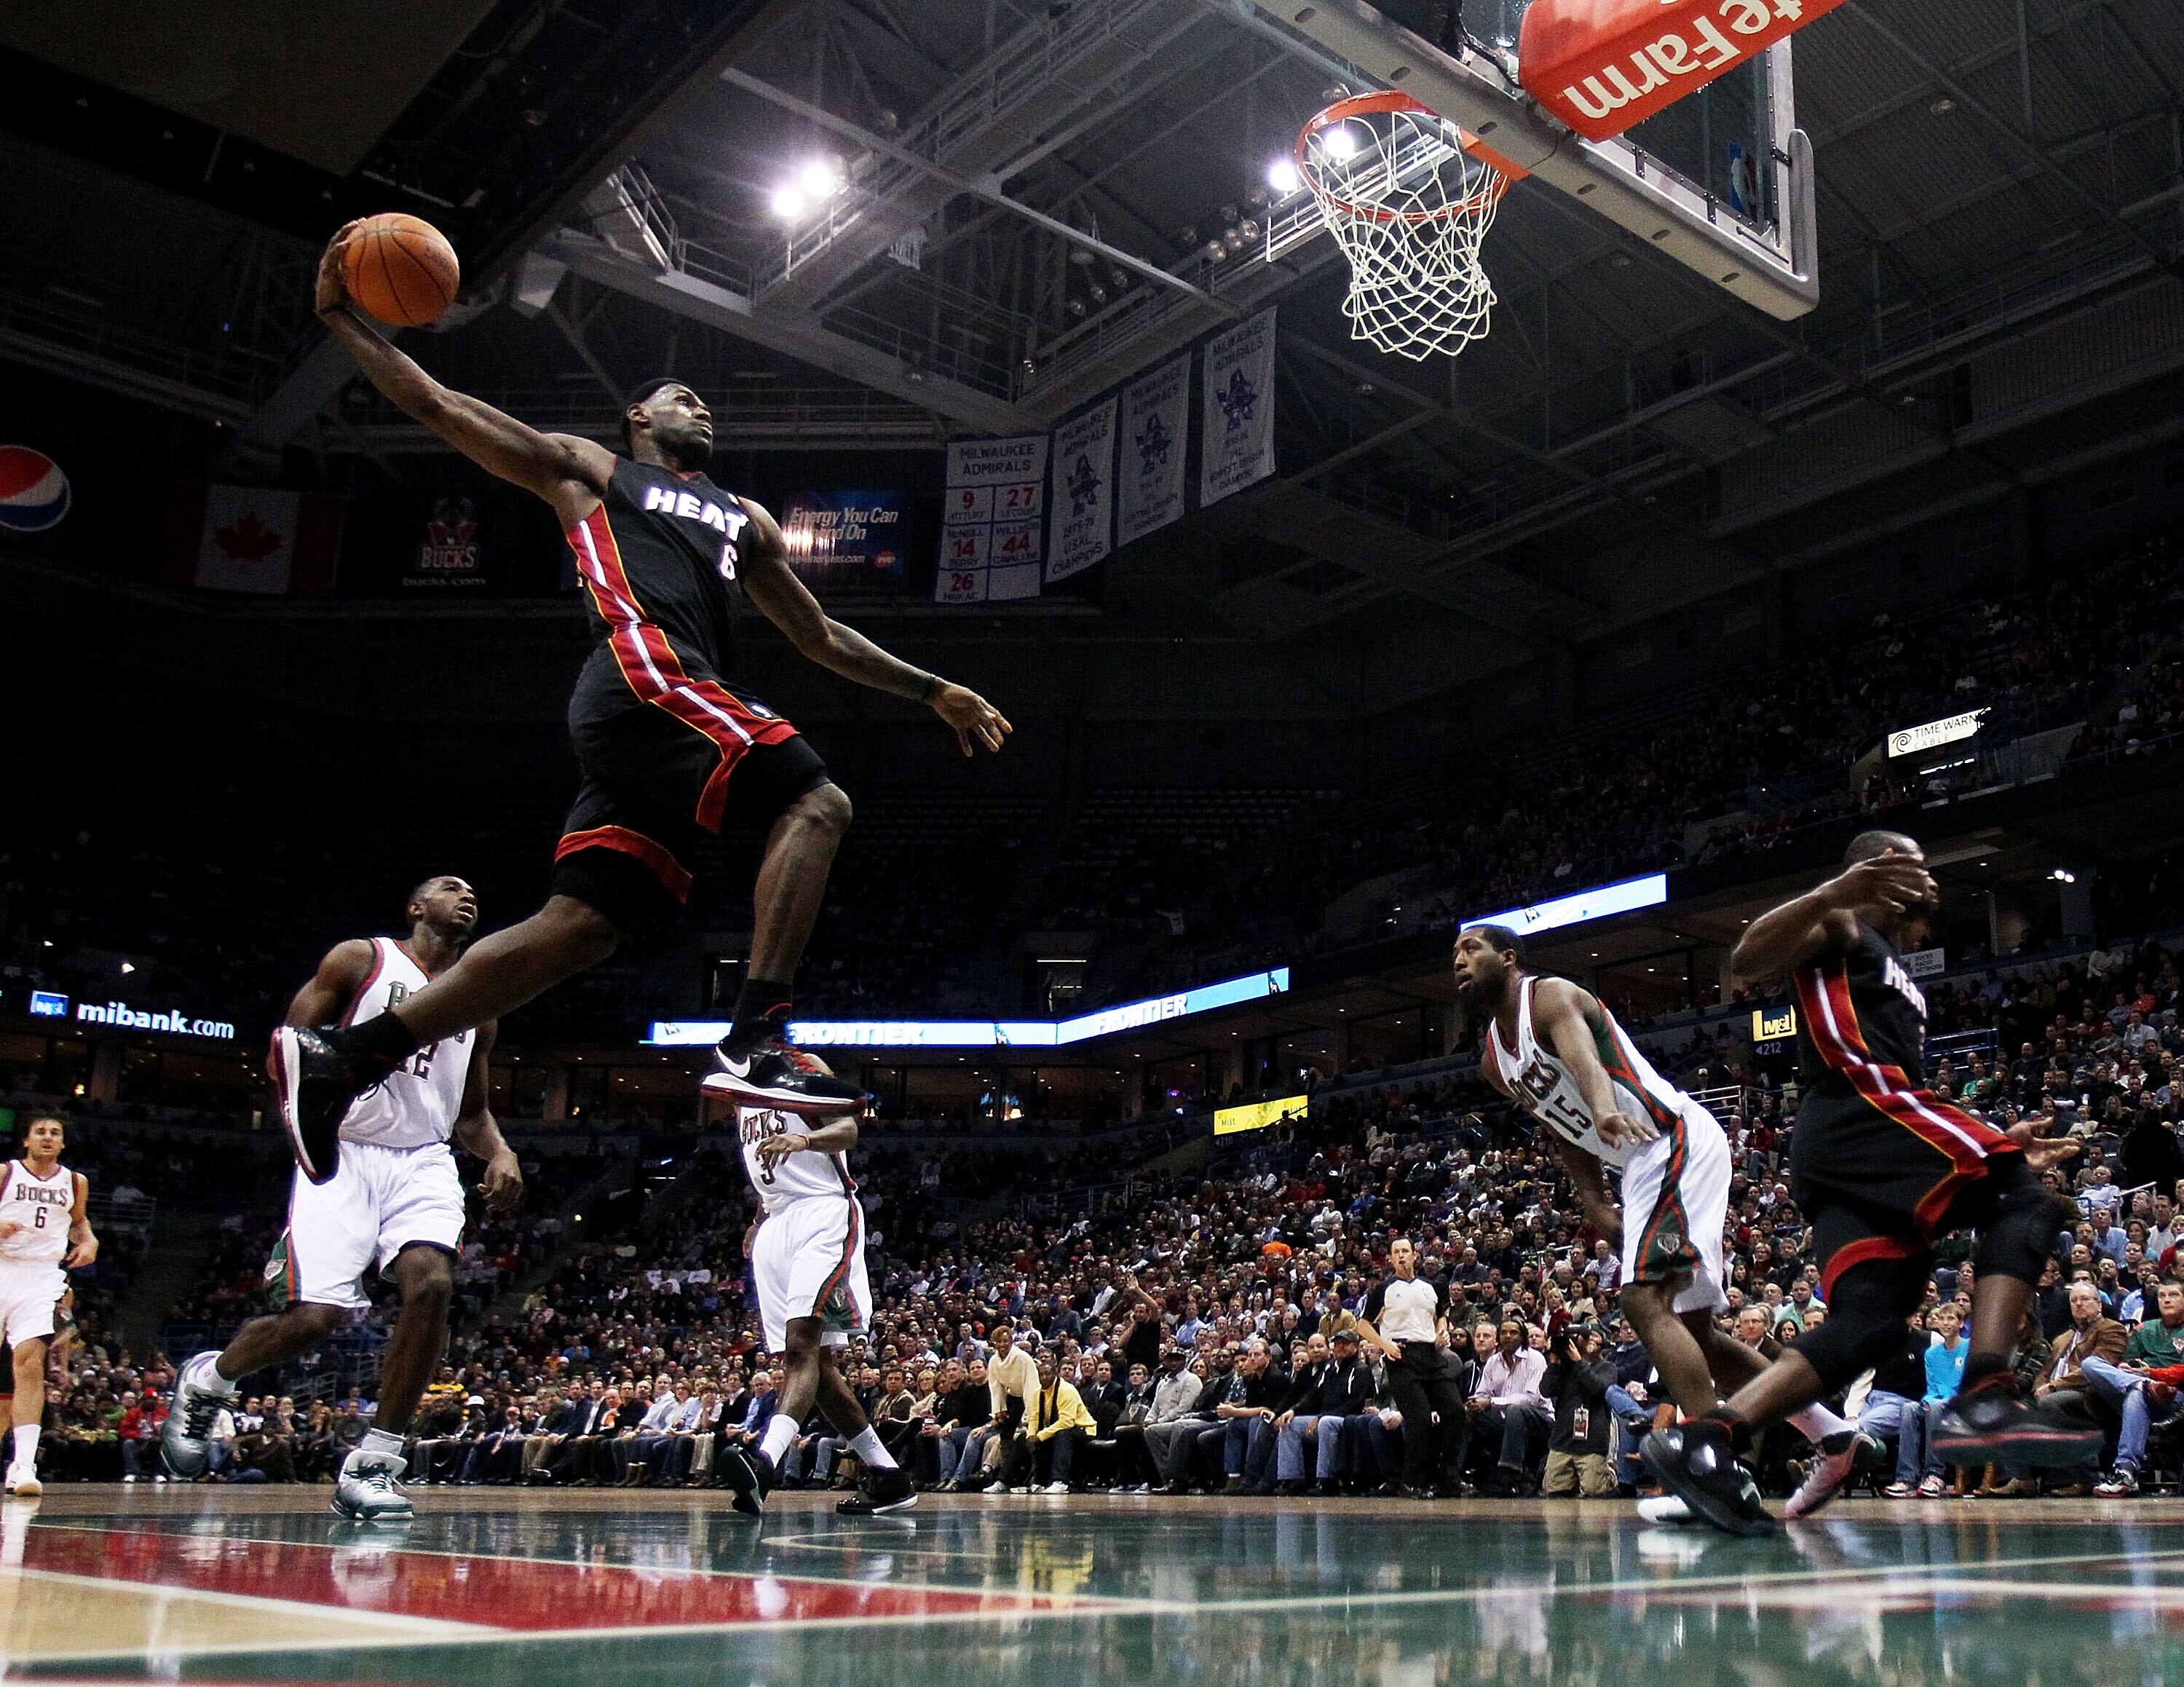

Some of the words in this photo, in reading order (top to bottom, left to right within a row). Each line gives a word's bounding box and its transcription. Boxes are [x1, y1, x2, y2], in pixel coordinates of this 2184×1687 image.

[1563, 15, 1741, 119] Farm
[960, 443, 1037, 459] MILWAUKEE
[963, 459, 1032, 475] ADMIRALS
[962, 491, 975, 510] 9
[1007, 487, 1034, 507] 27
[646, 486, 749, 542] HEAT
[791, 507, 842, 527] Energy
[844, 507, 870, 524] You
[871, 507, 899, 524] Can
[847, 524, 866, 540] On
[953, 538, 975, 558] 14
[1002, 533, 1030, 553] 44
[421, 545, 477, 569] BUCKS
[721, 544, 738, 581] 6
[951, 572, 974, 592] 26
[1915, 724, 1942, 738] TIME
[1944, 714, 1977, 730] WARN
[1914, 734, 1950, 749] CABLE
[77, 1001, 235, 1040] mibank.com
[1095, 993, 1188, 1035] FRONTIER
[1763, 1041, 1782, 1056] 212
[1222, 1118, 1235, 1127] Mist
[1545, 1094, 1594, 1140] 15
[15, 1183, 68, 1206] BUCKS
[35, 1206, 48, 1228] 6
